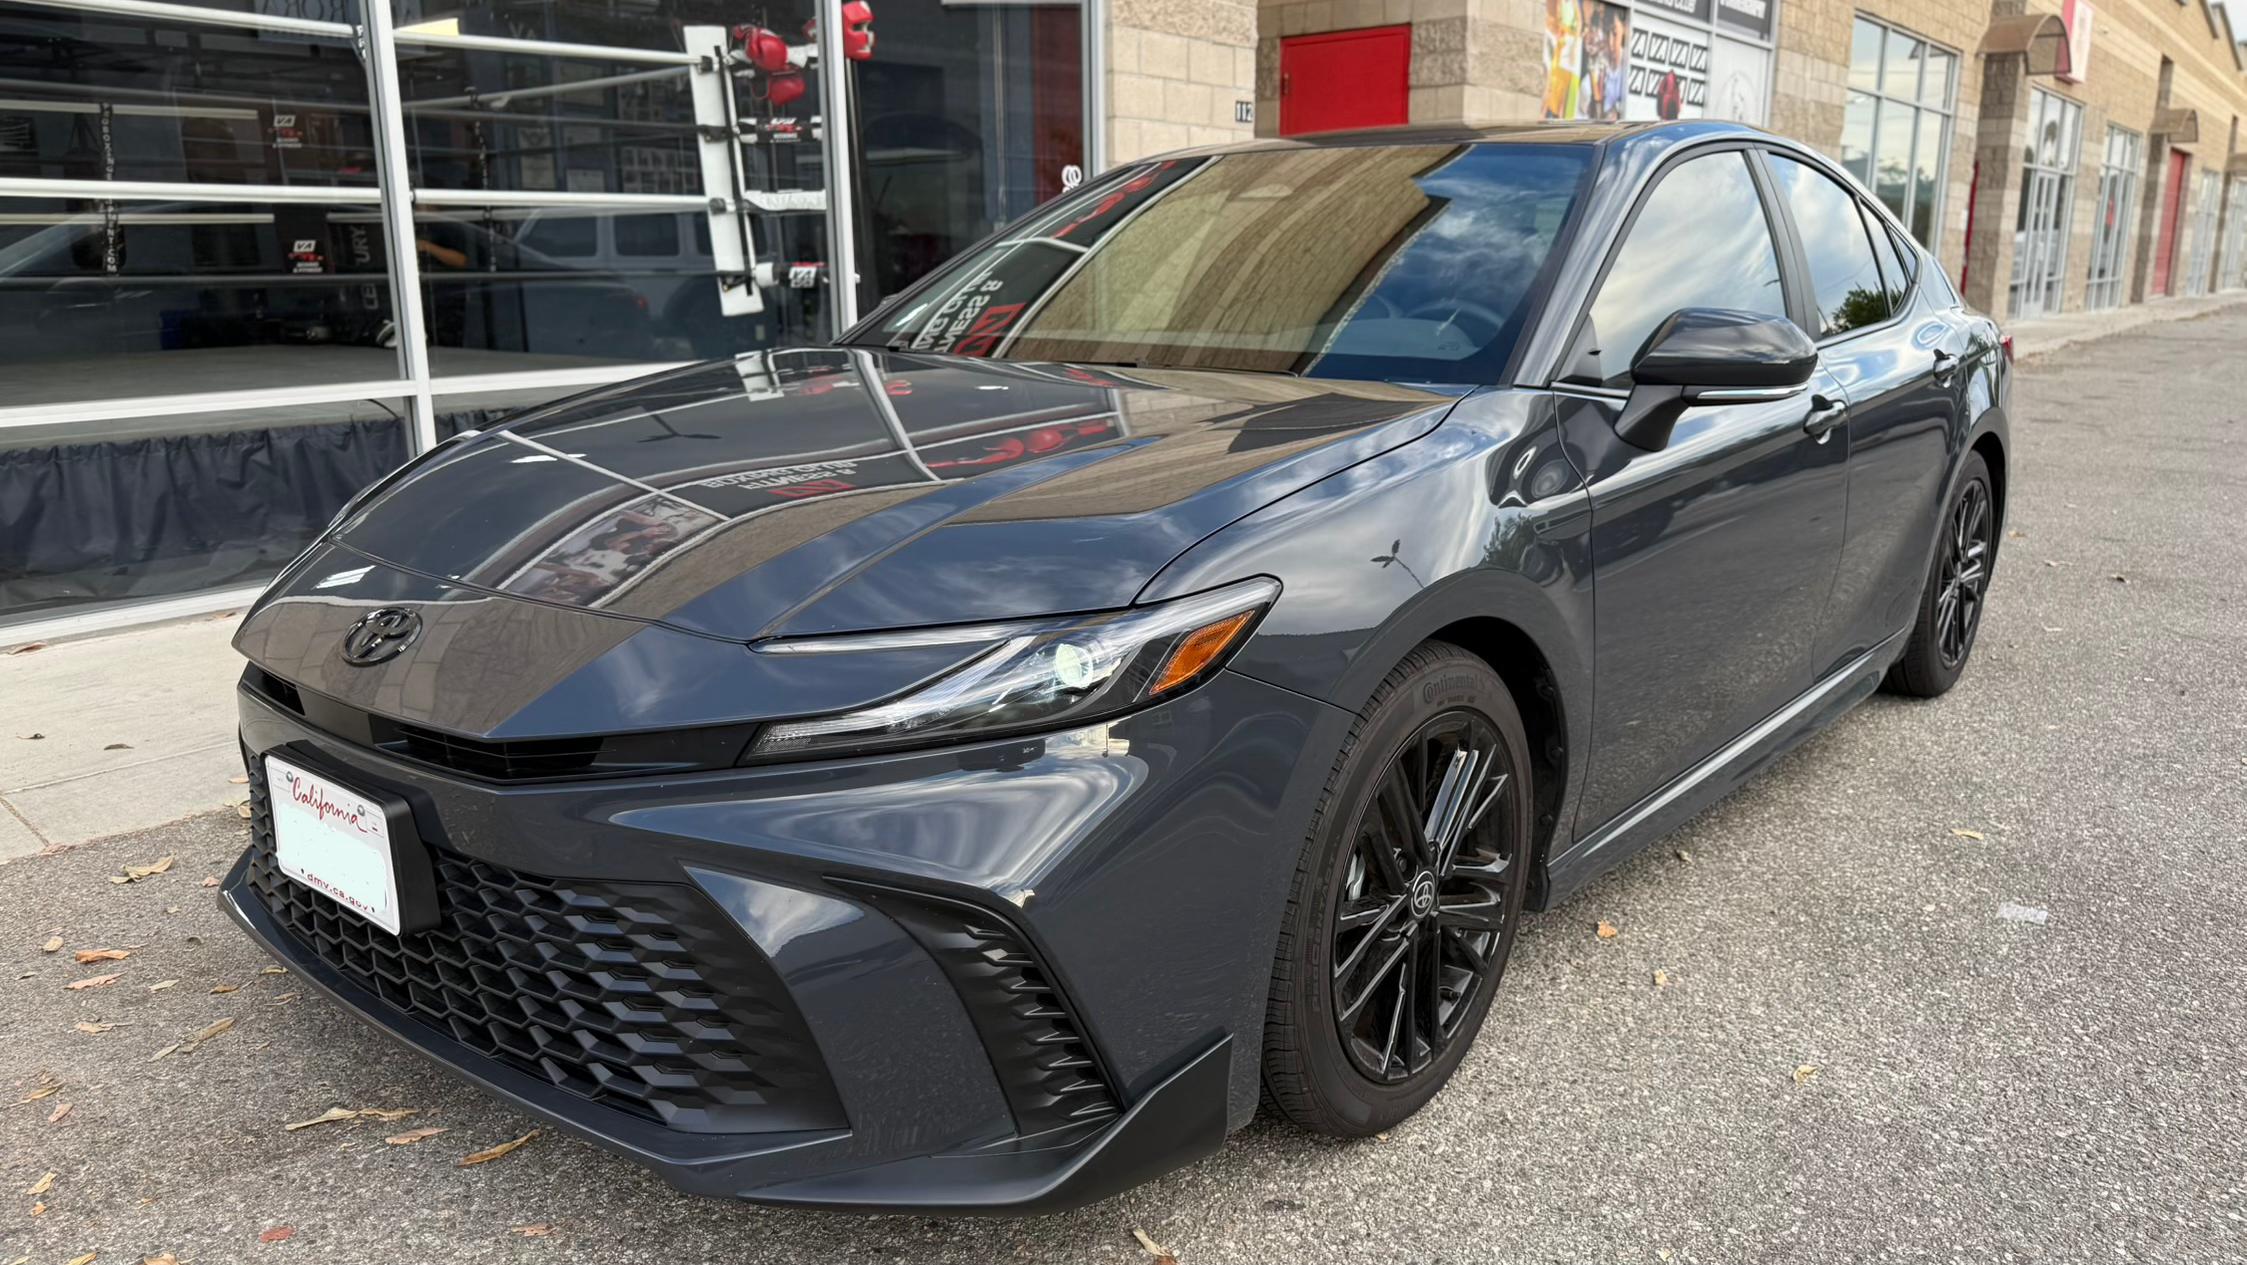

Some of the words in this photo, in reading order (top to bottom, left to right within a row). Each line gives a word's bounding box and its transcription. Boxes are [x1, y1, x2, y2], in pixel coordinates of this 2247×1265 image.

[1648, 35, 1669, 62] VA
[1669, 40, 1689, 67] VA
[292, 776, 368, 834] California
[307, 873, 370, 912] dmv.ca.gov
